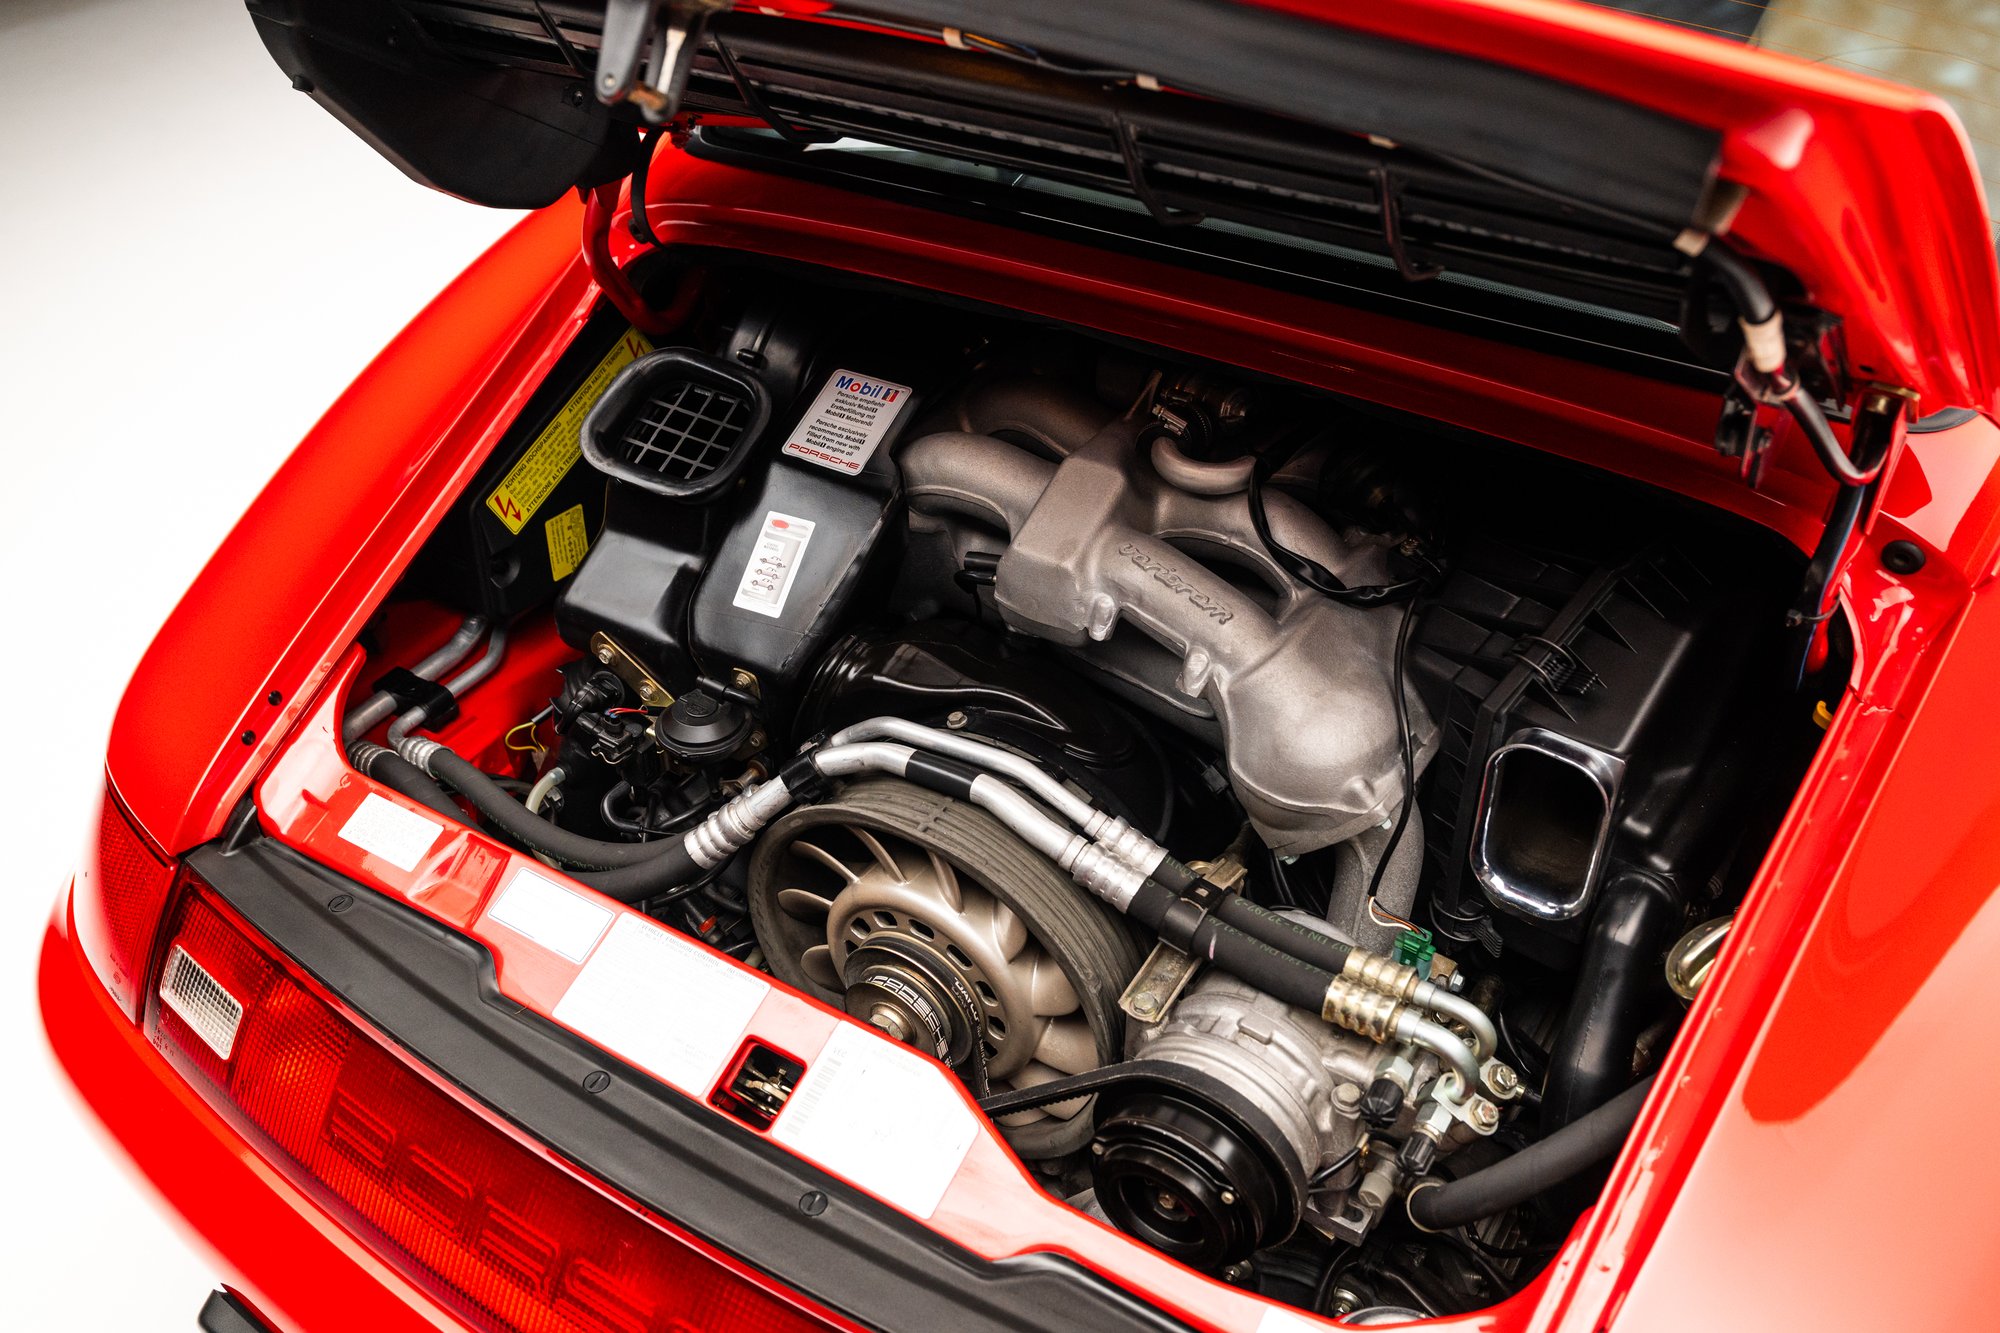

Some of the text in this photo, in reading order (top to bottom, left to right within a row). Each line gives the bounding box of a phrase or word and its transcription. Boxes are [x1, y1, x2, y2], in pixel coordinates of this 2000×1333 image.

[568, 384, 593, 413] ATTENTION
[591, 367, 607, 385] HAUTE
[605, 344, 625, 368] TENSION
[836, 376, 883, 398] Mobil
[835, 398, 858, 408] exklusiv
[837, 391, 886, 408] Porsche empfiehlt
[830, 403, 866, 419] Erstbefüllung
[815, 419, 868, 438] Porsche exclusively
[845, 415, 873, 427] Motorenöl
[809, 425, 844, 438] recommends
[822, 434, 835, 443] from
[848, 442, 861, 451] with
[826, 444, 845, 455] engine
[504, 421, 562, 490] ACHTUNG HOCHSPANNUNG
[789, 443, 860, 470] PORSCHE
[526, 479, 553, 513] ATTENZIONE
[551, 465, 564, 481] ALTA
[1307, 931, 1329, 945] DN
